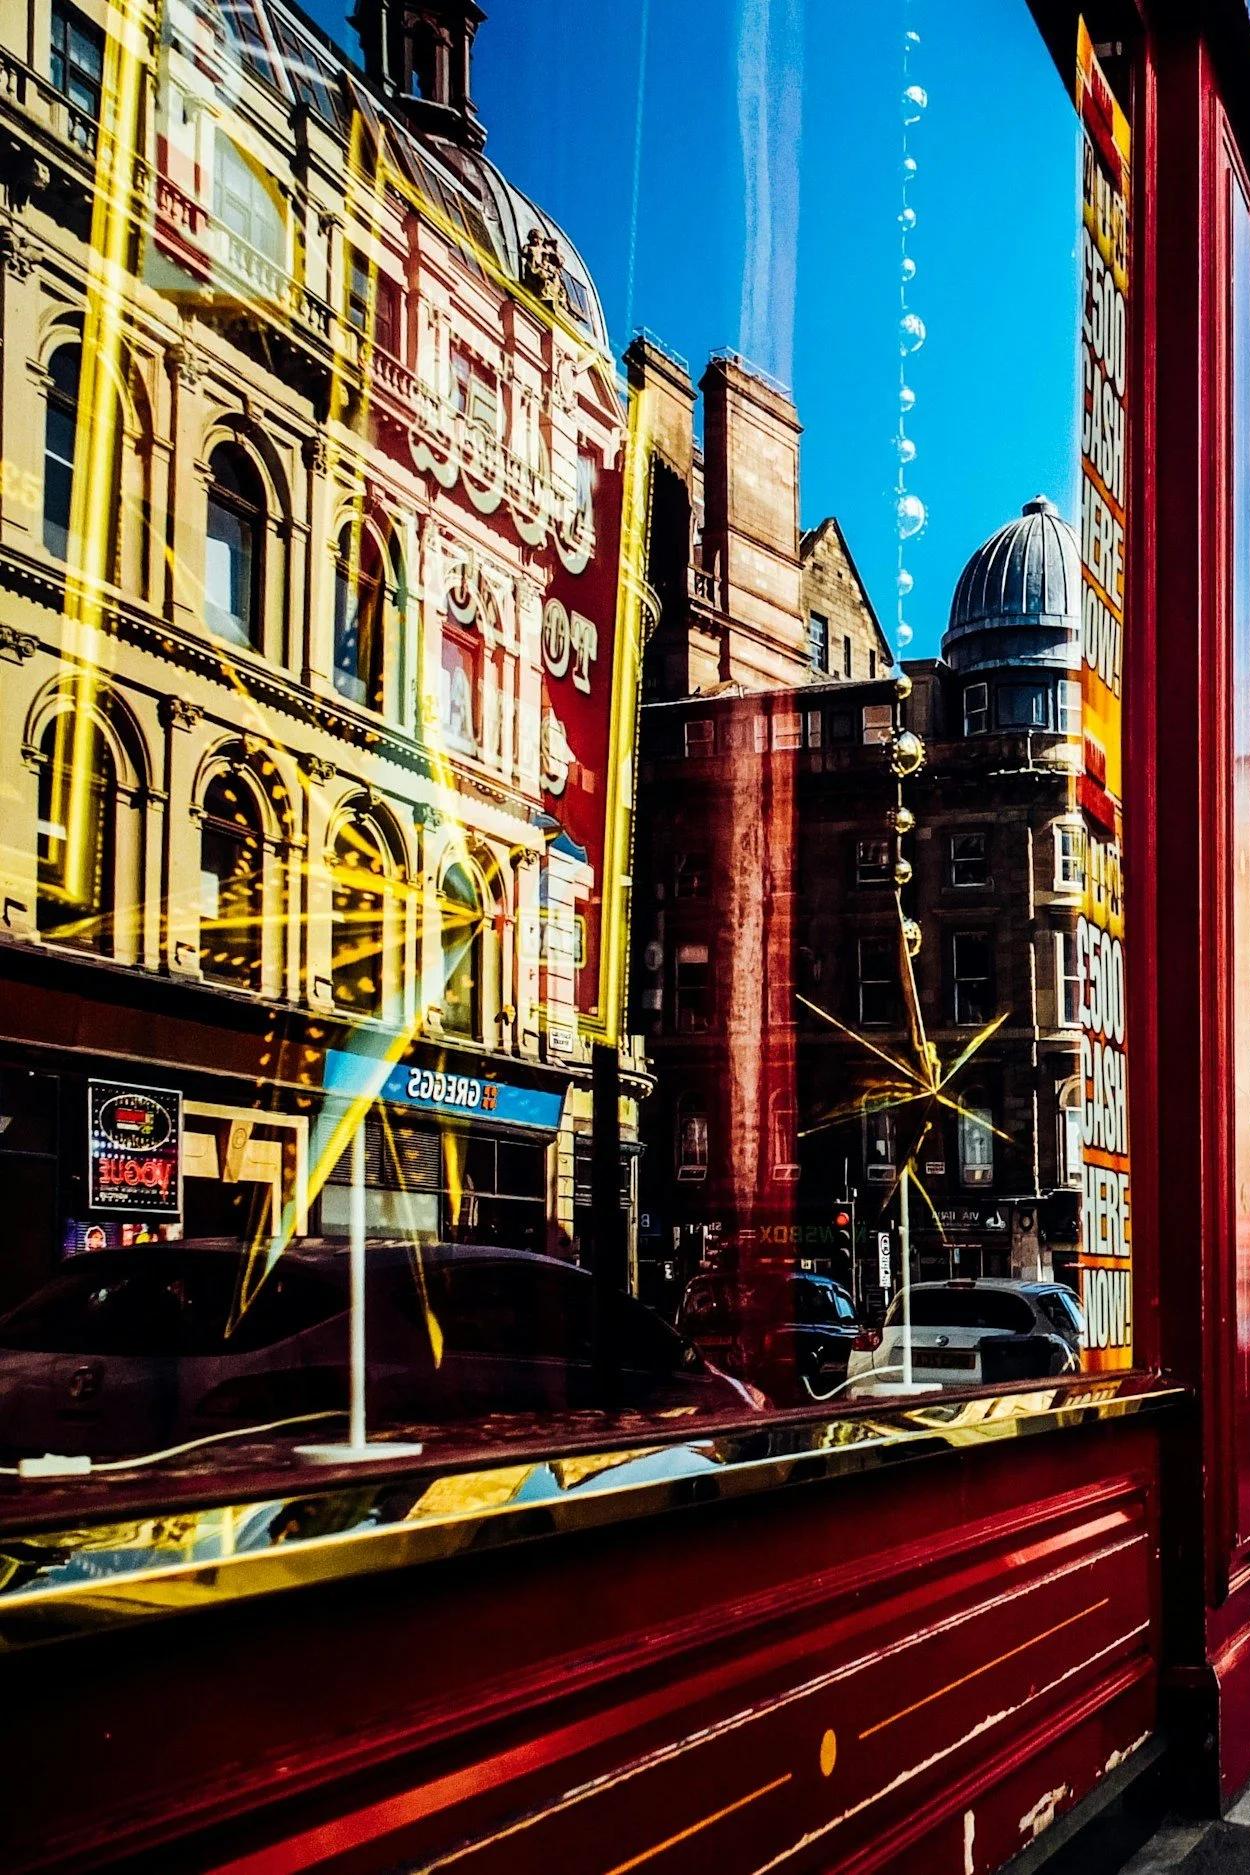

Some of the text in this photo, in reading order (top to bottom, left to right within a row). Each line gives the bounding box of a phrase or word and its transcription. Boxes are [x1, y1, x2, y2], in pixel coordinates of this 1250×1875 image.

[1082, 341, 1126, 510] CASH
[1077, 914, 1127, 1046] £500
[1080, 1033, 1128, 1156] CASH
[1082, 1162, 1131, 1259] HERE
[1083, 1267, 1133, 1350] NOW!
